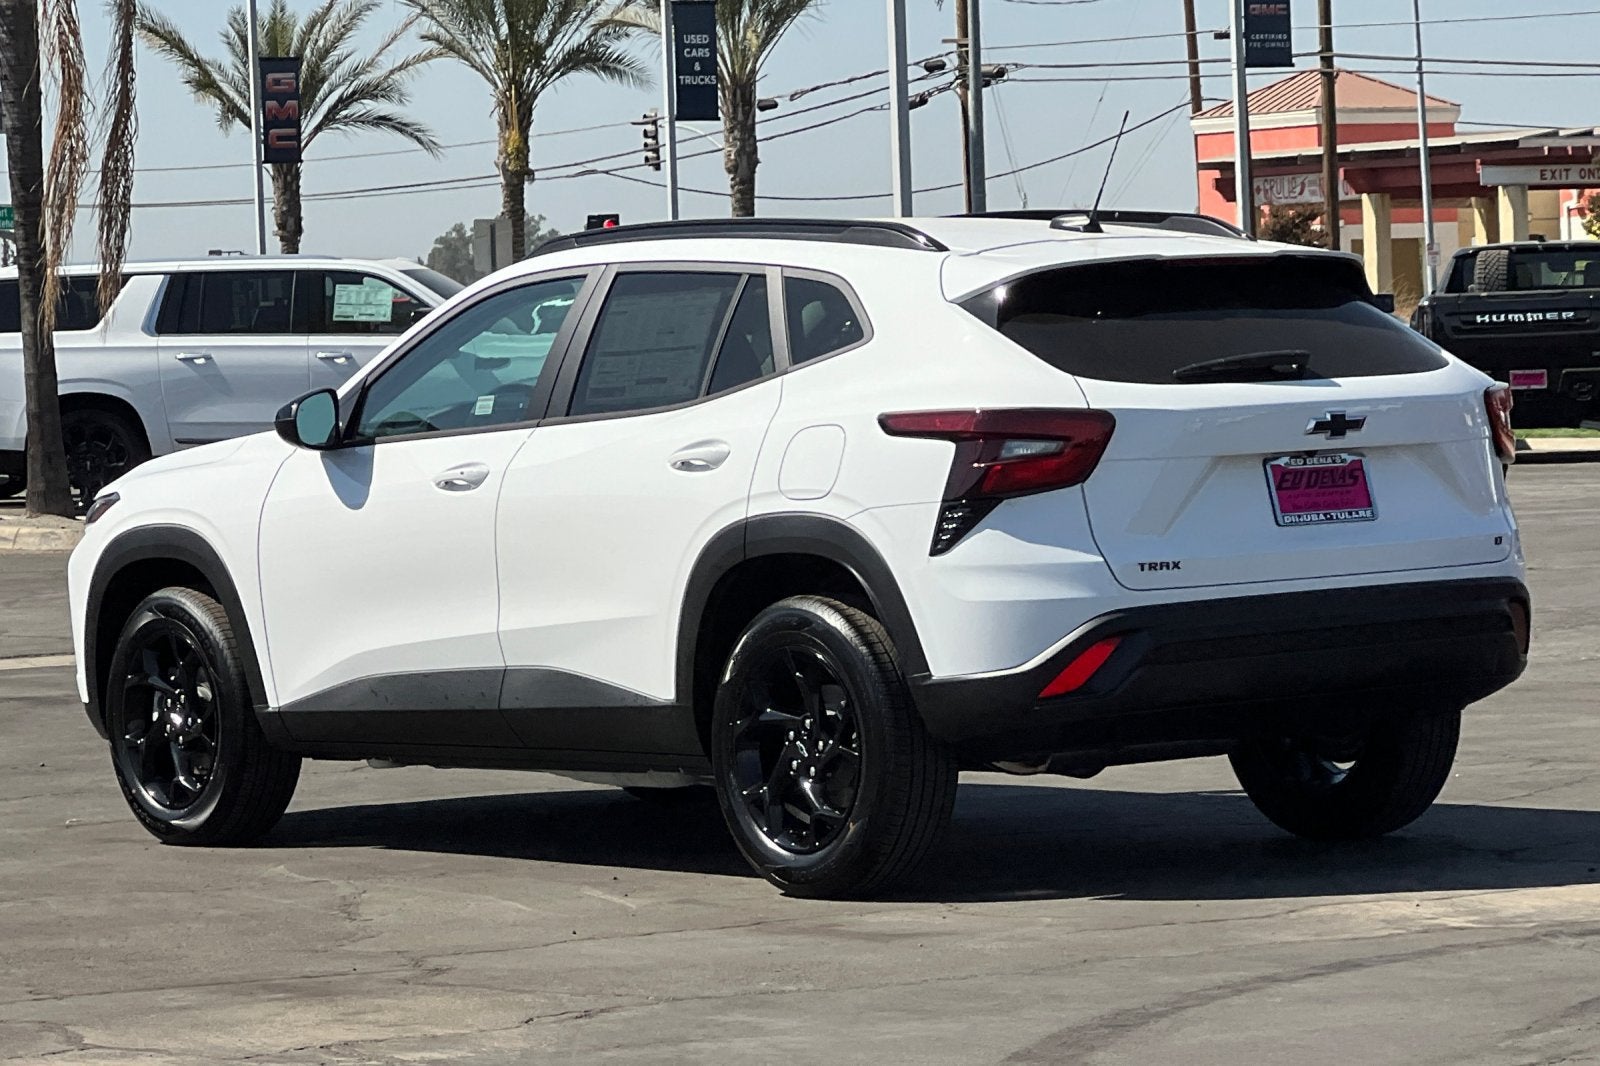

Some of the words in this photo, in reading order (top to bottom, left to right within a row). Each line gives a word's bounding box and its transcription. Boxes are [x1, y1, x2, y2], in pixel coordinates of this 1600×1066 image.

[1250, 4, 1287, 15] GMC
[683, 35, 709, 44] USED
[683, 48, 710, 57] CARS
[693, 61, 701, 71] &
[679, 75, 717, 85] TRUCKS
[265, 72, 299, 149] GMC
[1540, 168, 1572, 180] EXIT
[1476, 311, 1575, 323] HUMMER
[1290, 458, 1304, 466] ED
[1138, 561, 1182, 572] TRAX
